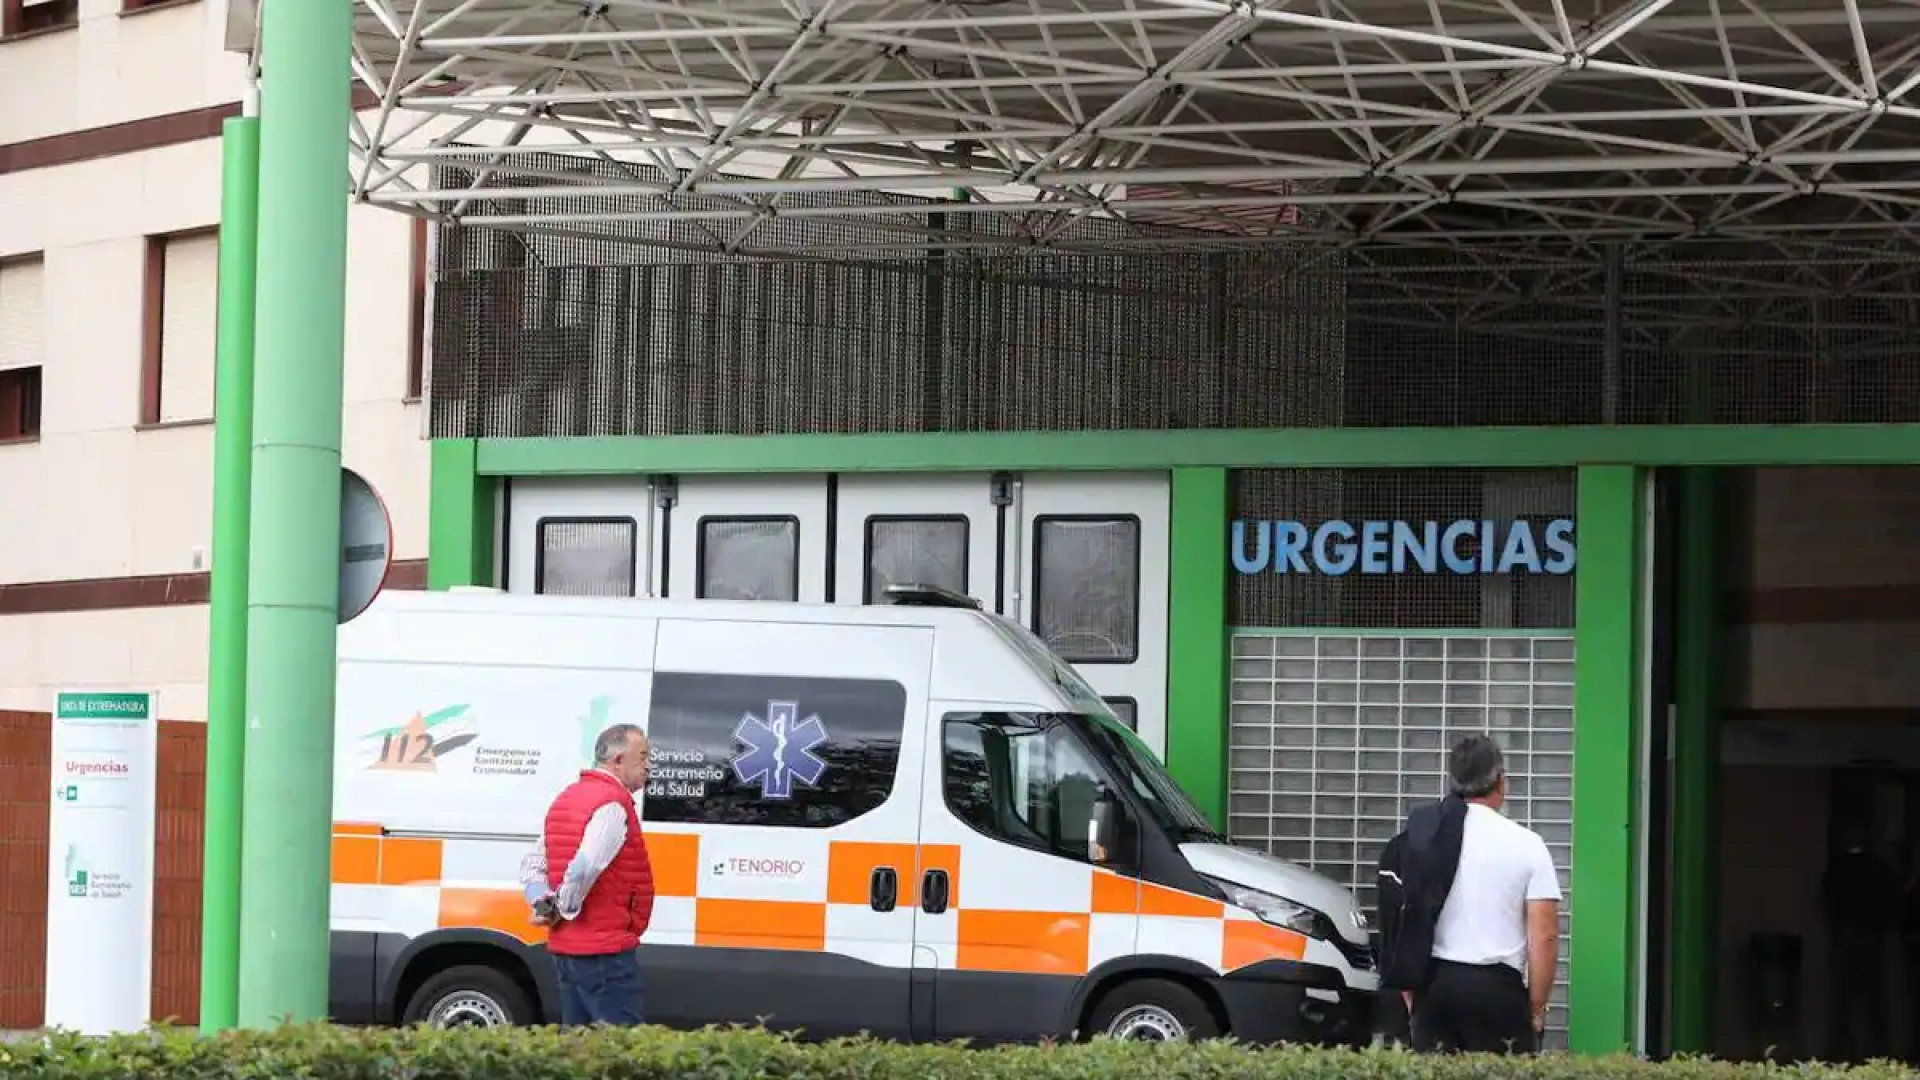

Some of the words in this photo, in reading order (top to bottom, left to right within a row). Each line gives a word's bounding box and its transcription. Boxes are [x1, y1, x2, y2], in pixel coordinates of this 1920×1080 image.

[1231, 519, 1576, 576] URGENCIAS
[88, 701, 145, 712] EXTREMADURA
[381, 732, 435, 763] 112
[526, 758, 539, 766] de
[650, 749, 705, 762] Servicio
[66, 760, 129, 775] Urgencias
[650, 764, 724, 780] Extremeño
[647, 781, 665, 796] de
[668, 781, 705, 796] Salud
[729, 858, 803, 874] TENORIO
